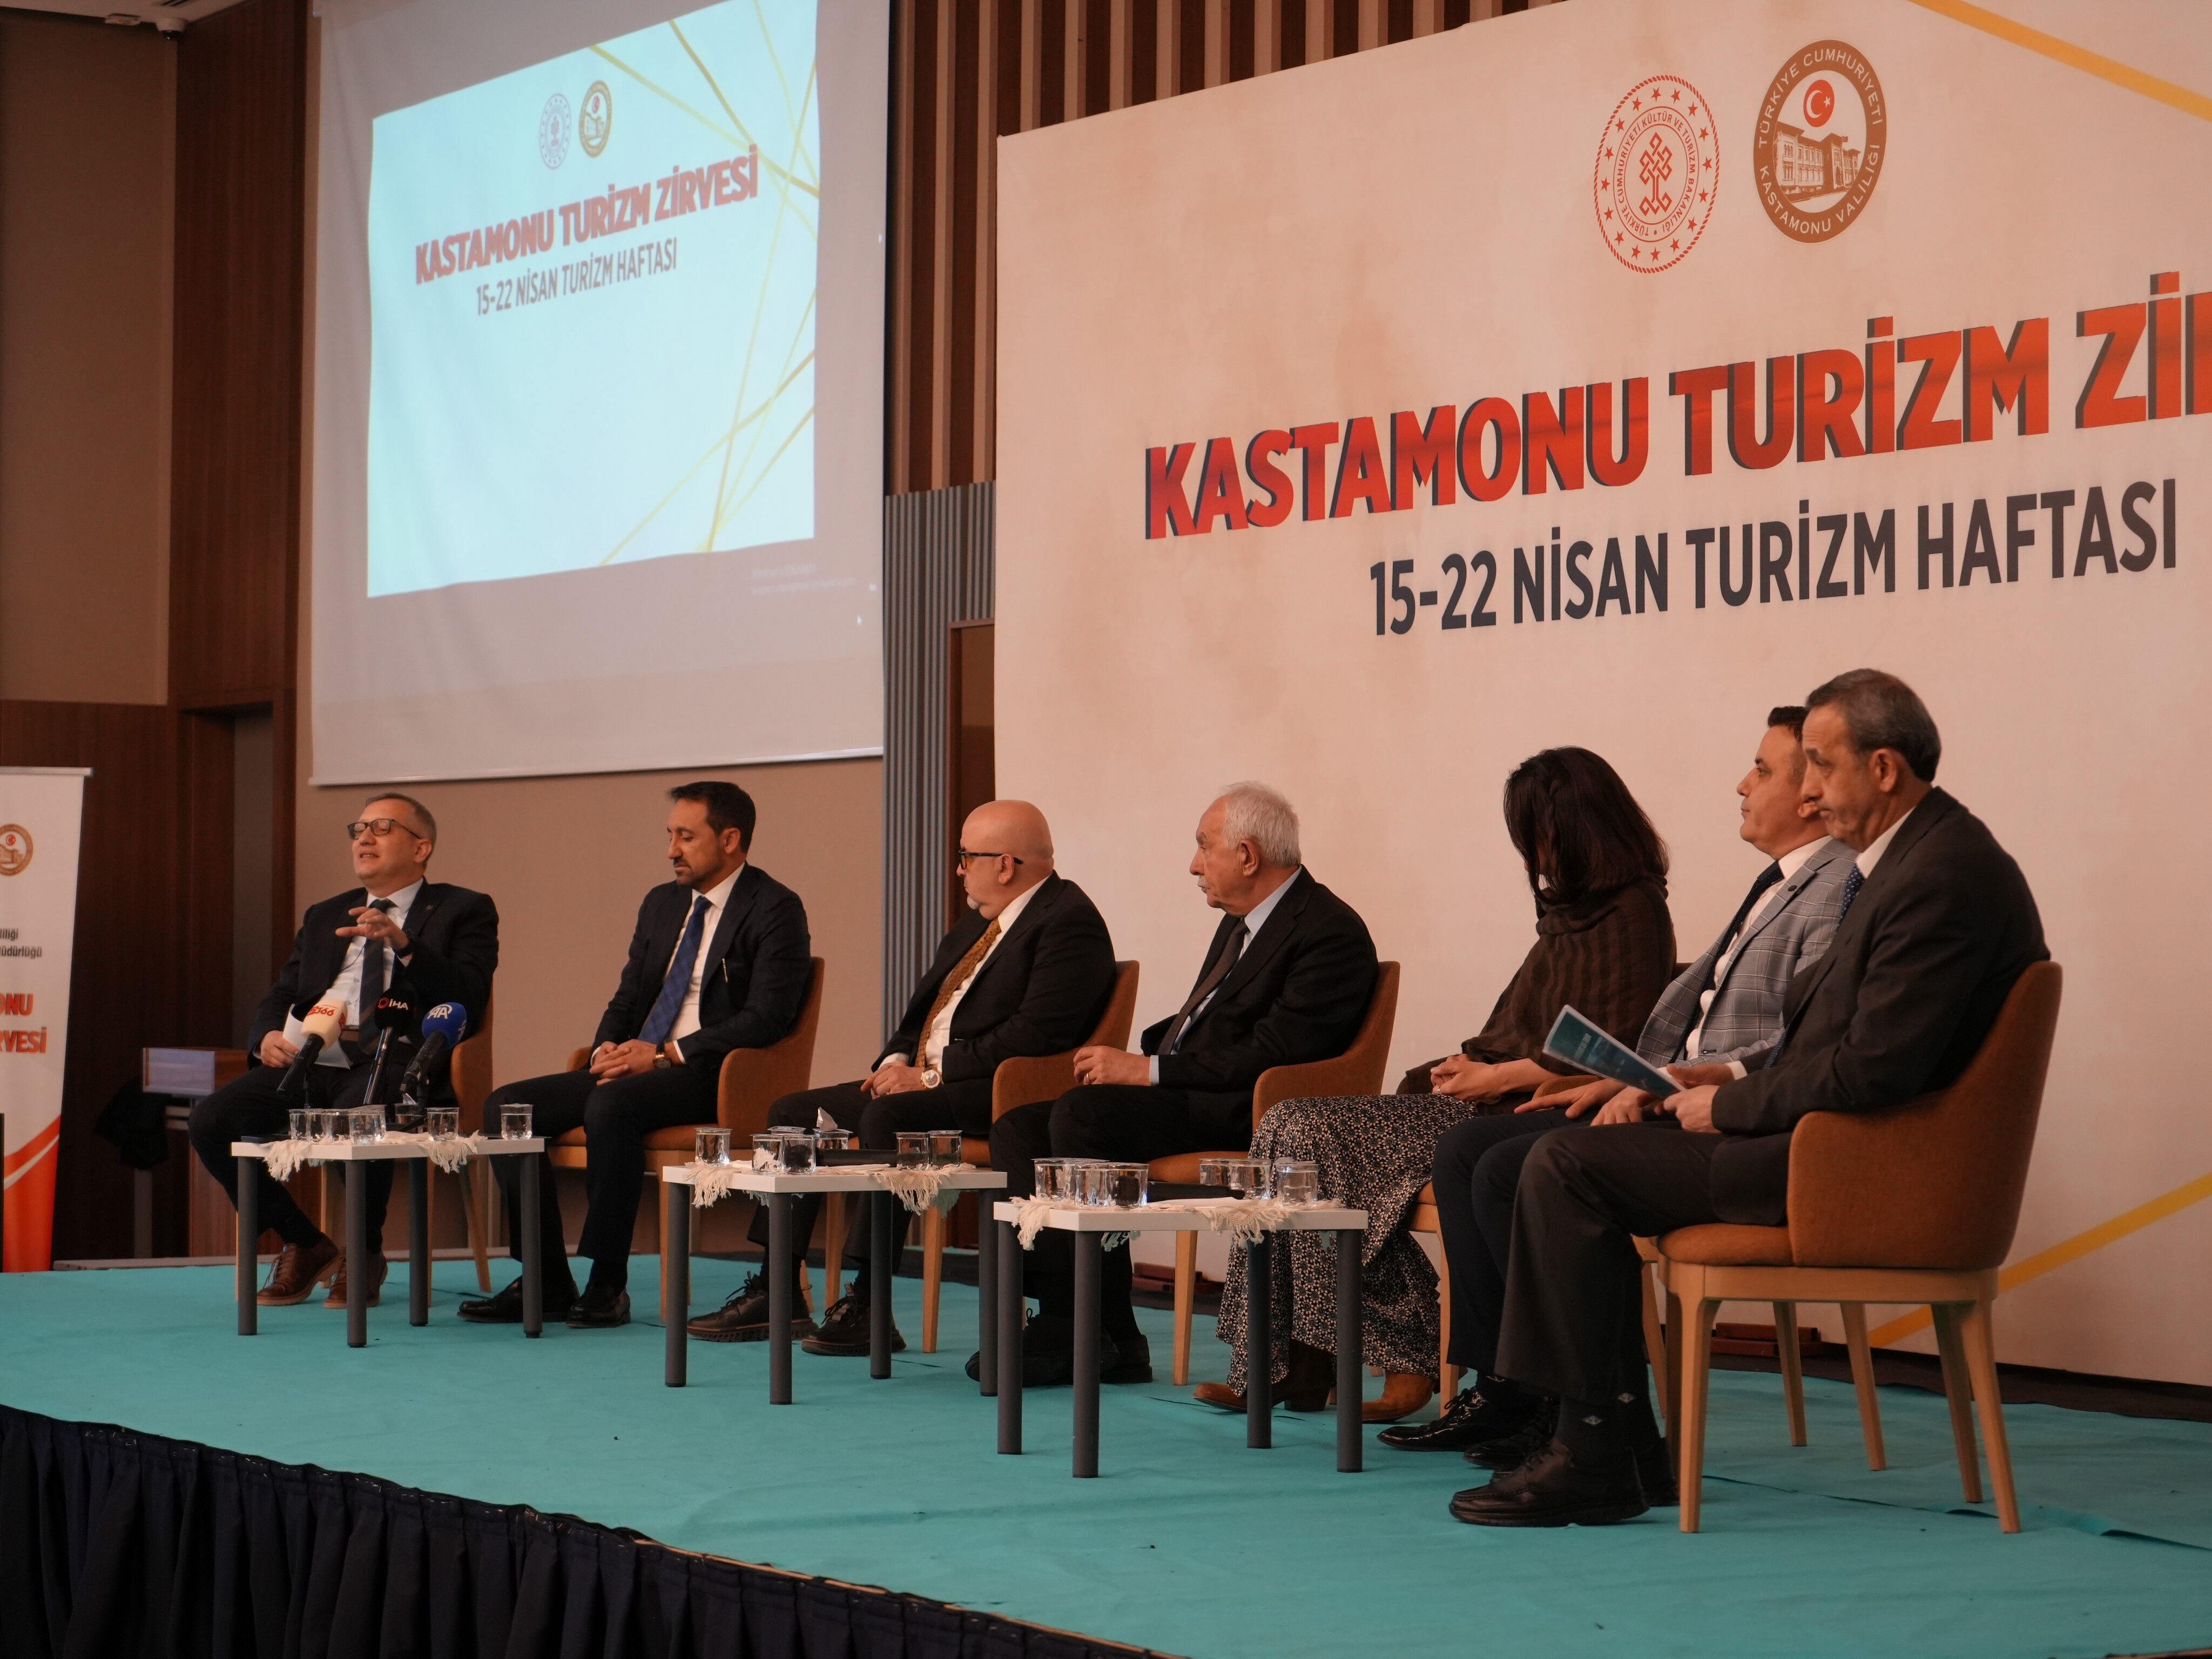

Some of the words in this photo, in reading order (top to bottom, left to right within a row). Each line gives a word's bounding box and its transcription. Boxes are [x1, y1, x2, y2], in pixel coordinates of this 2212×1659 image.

[1642, 110, 1673, 128] KÜLTÜR
[1674, 117, 1683, 131] VE
[1682, 128, 1696, 173] TURİZM
[416, 209, 554, 285] KASTAMONU
[559, 184, 651, 246] TURİZM
[655, 144, 758, 222] ZİRVESİ
[1759, 165, 1831, 234] KASTAMONU
[476, 278, 512, 316] 15-22
[516, 268, 558, 307] NİSAN
[562, 251, 614, 296] TURİZM
[617, 237, 678, 282] HAFTASI
[1145, 377, 1648, 539] KASTAMONU
[1669, 316, 2049, 476] TURİZM
[1371, 551, 1497, 636] 15-22
[1514, 526, 1668, 624] NİSAN
[1685, 499, 1896, 609] TURİZM
[1918, 478, 2176, 590] HAFTASI
